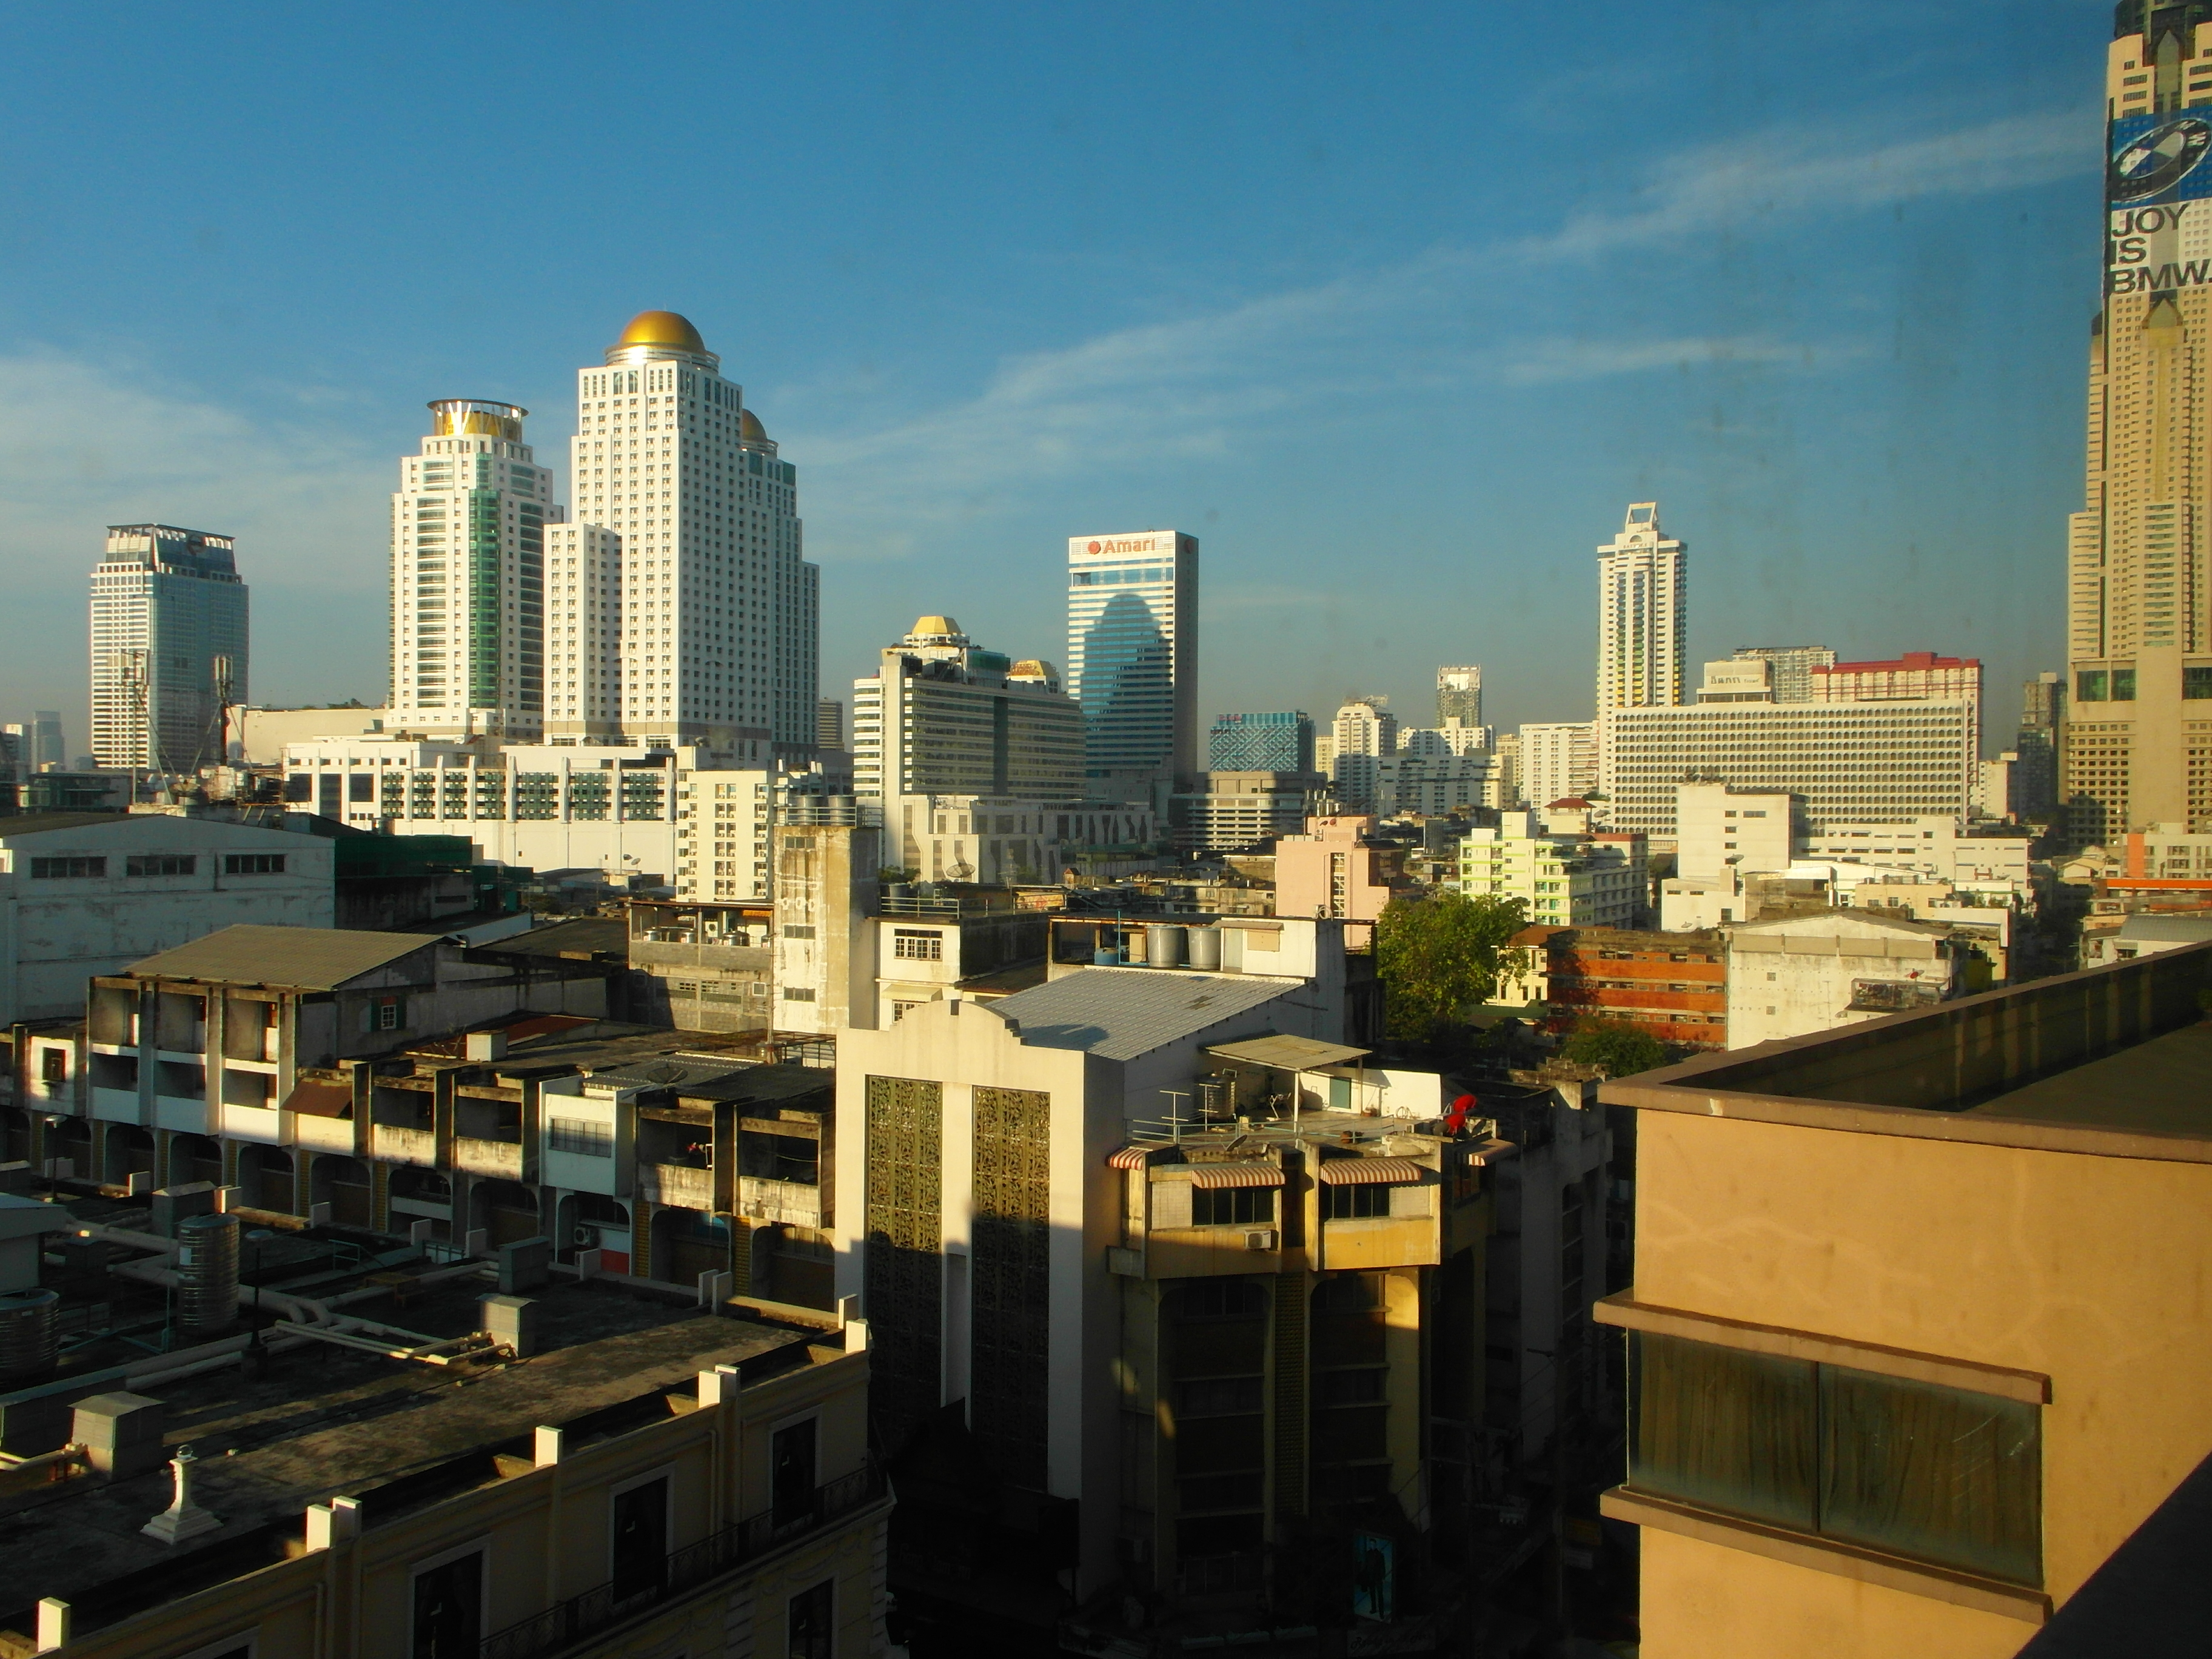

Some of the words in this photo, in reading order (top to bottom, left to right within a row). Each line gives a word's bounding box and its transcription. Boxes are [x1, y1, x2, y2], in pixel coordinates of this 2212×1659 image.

[2112, 202, 2191, 237] JOY
[2110, 237, 2147, 265] IS
[1102, 538, 1155, 554] Amari
